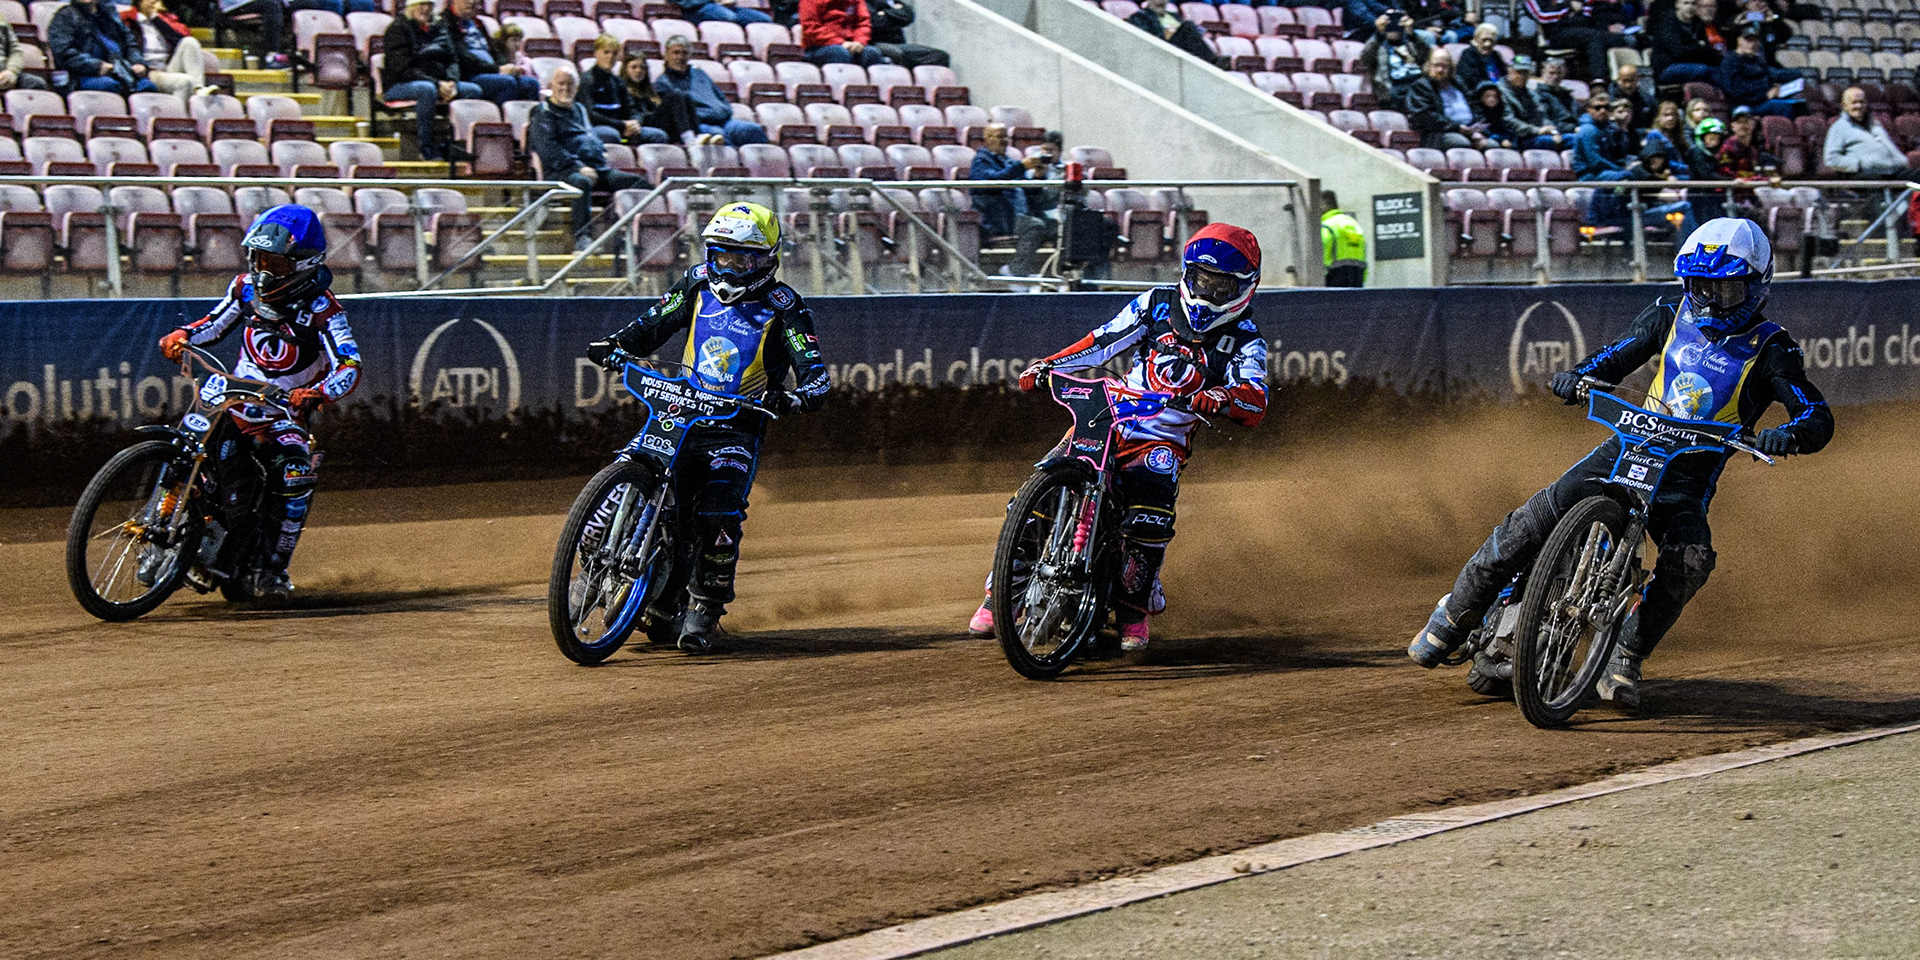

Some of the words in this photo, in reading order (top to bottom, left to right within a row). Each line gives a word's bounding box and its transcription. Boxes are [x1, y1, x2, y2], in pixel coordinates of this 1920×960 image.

[1375, 199, 1404, 210] BLOCK
[1405, 197, 1413, 208] C
[1376, 223, 1405, 234] BLOCK
[1523, 340, 1571, 375] ATPI
[1702, 360, 1726, 374] Omada
[5, 361, 198, 422] olution
[431, 366, 500, 408] ATPI
[640, 375, 683, 395] INDUSTRIAL
[684, 388, 692, 397] &
[1062, 386, 1094, 399] JPR
[659, 390, 697, 409] SERVICES
[1619, 410, 1659, 431] BCS
[1680, 431, 1698, 442] Ltd
[645, 434, 672, 450] CDS
